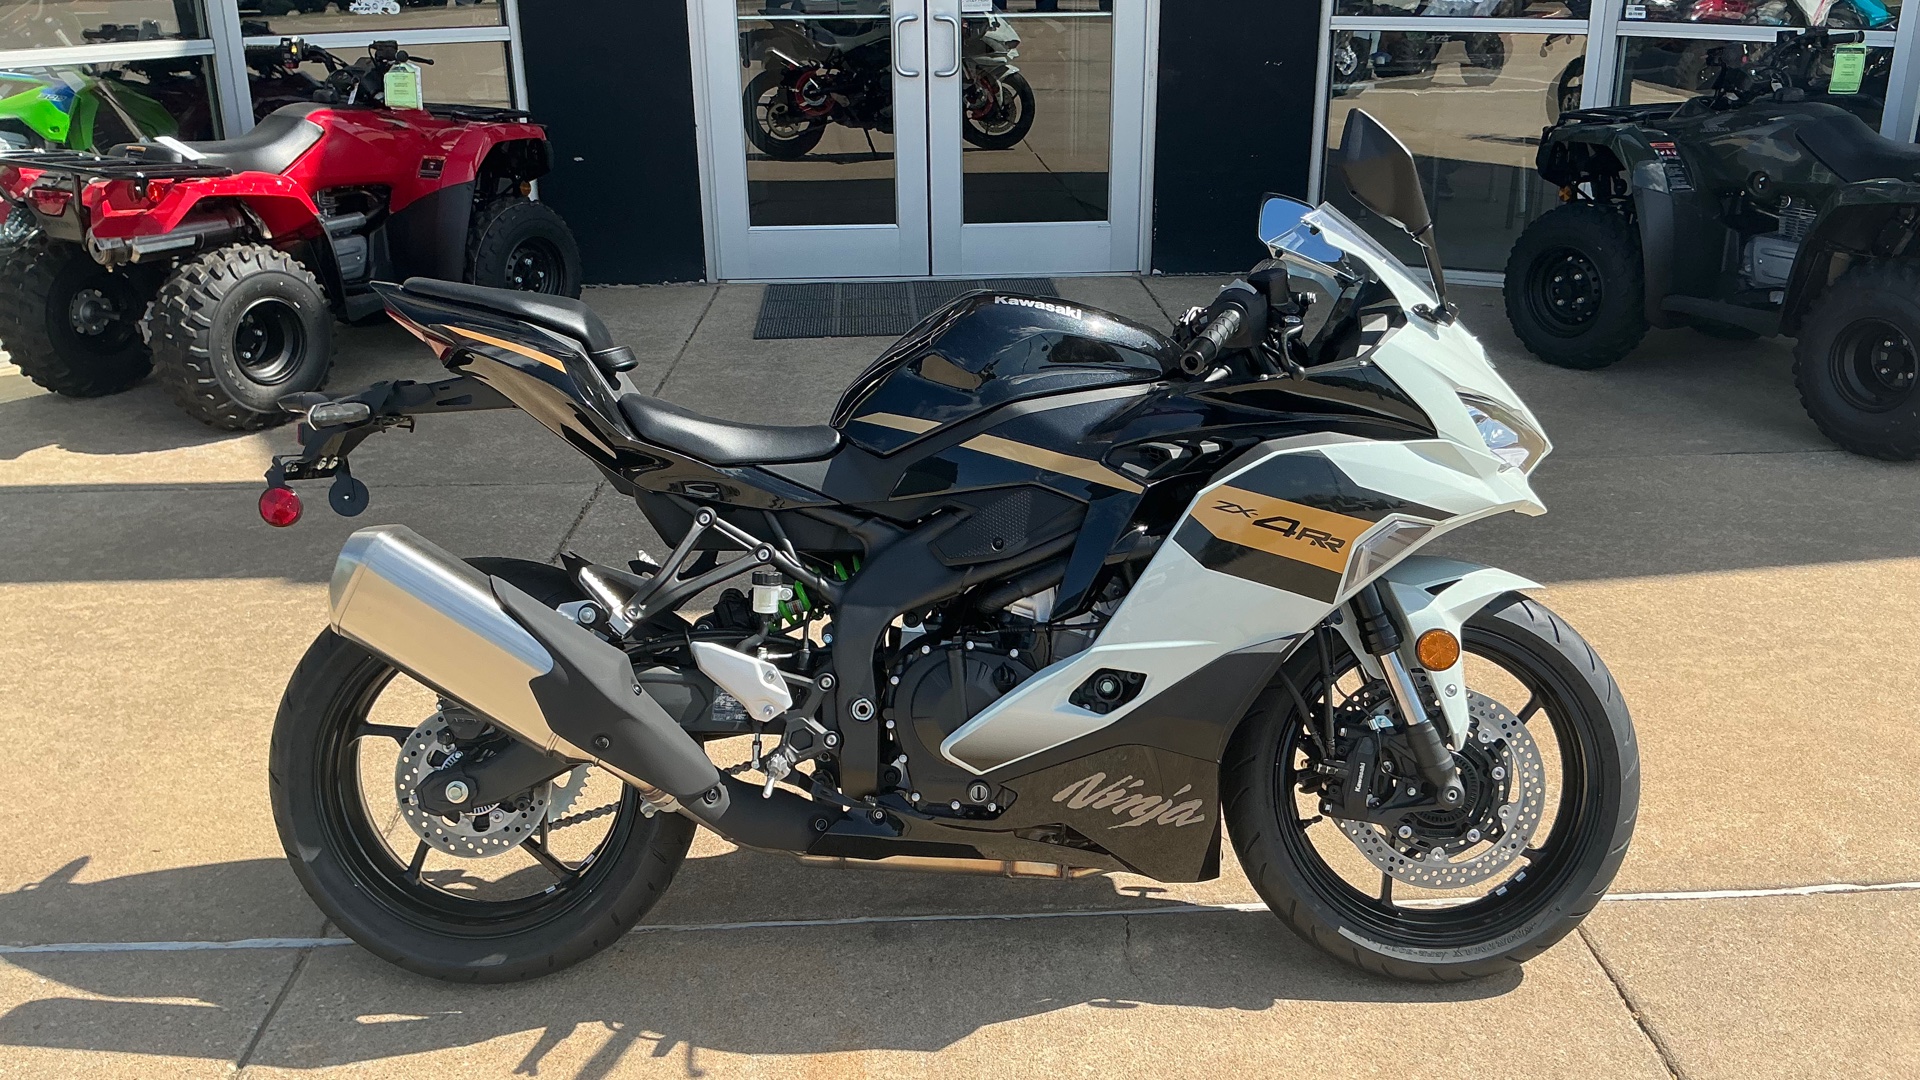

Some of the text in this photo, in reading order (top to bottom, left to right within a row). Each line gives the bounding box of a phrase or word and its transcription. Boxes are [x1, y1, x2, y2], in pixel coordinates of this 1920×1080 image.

[994, 296, 1082, 320] Kawasaki
[1354, 762, 1366, 792] Kawasaki
[1052, 772, 1205, 830] Ninja
